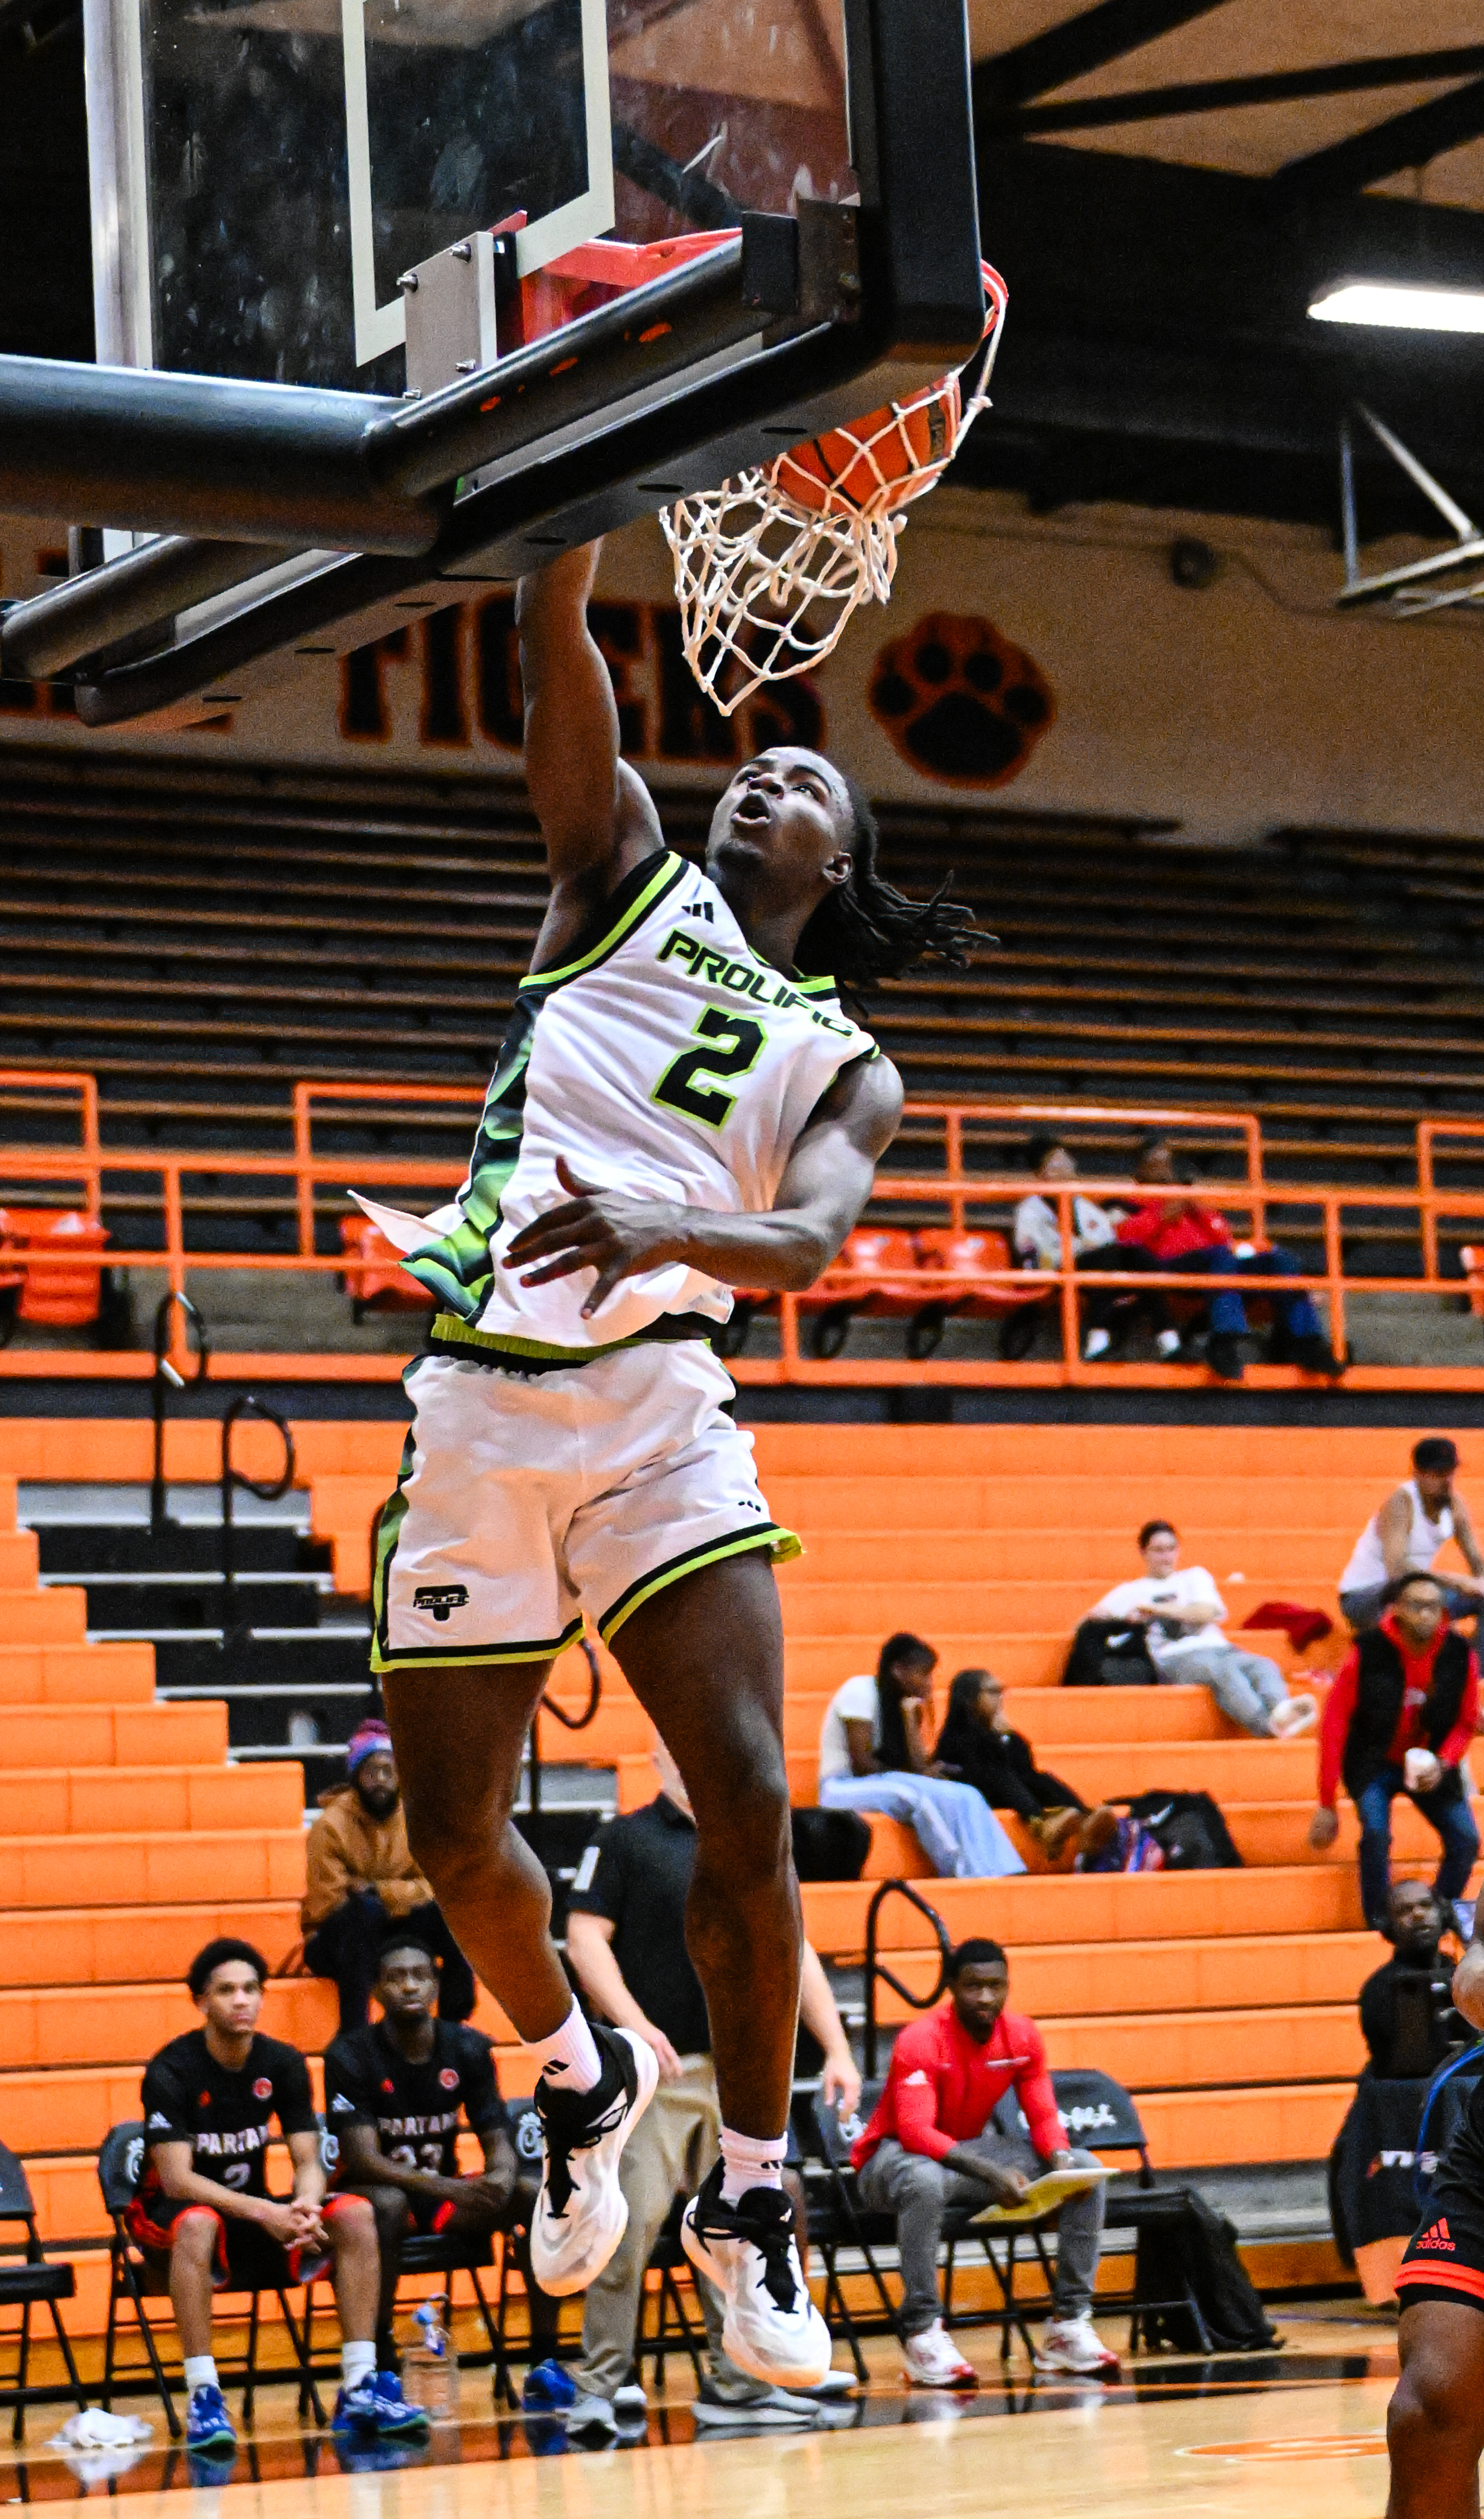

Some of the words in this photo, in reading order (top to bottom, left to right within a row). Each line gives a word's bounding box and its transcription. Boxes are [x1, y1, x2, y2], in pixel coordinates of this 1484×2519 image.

[656, 927, 856, 1040] PROLIFIC
[650, 1002, 769, 1134] 2
[1415, 2238, 1457, 2252] adidas
